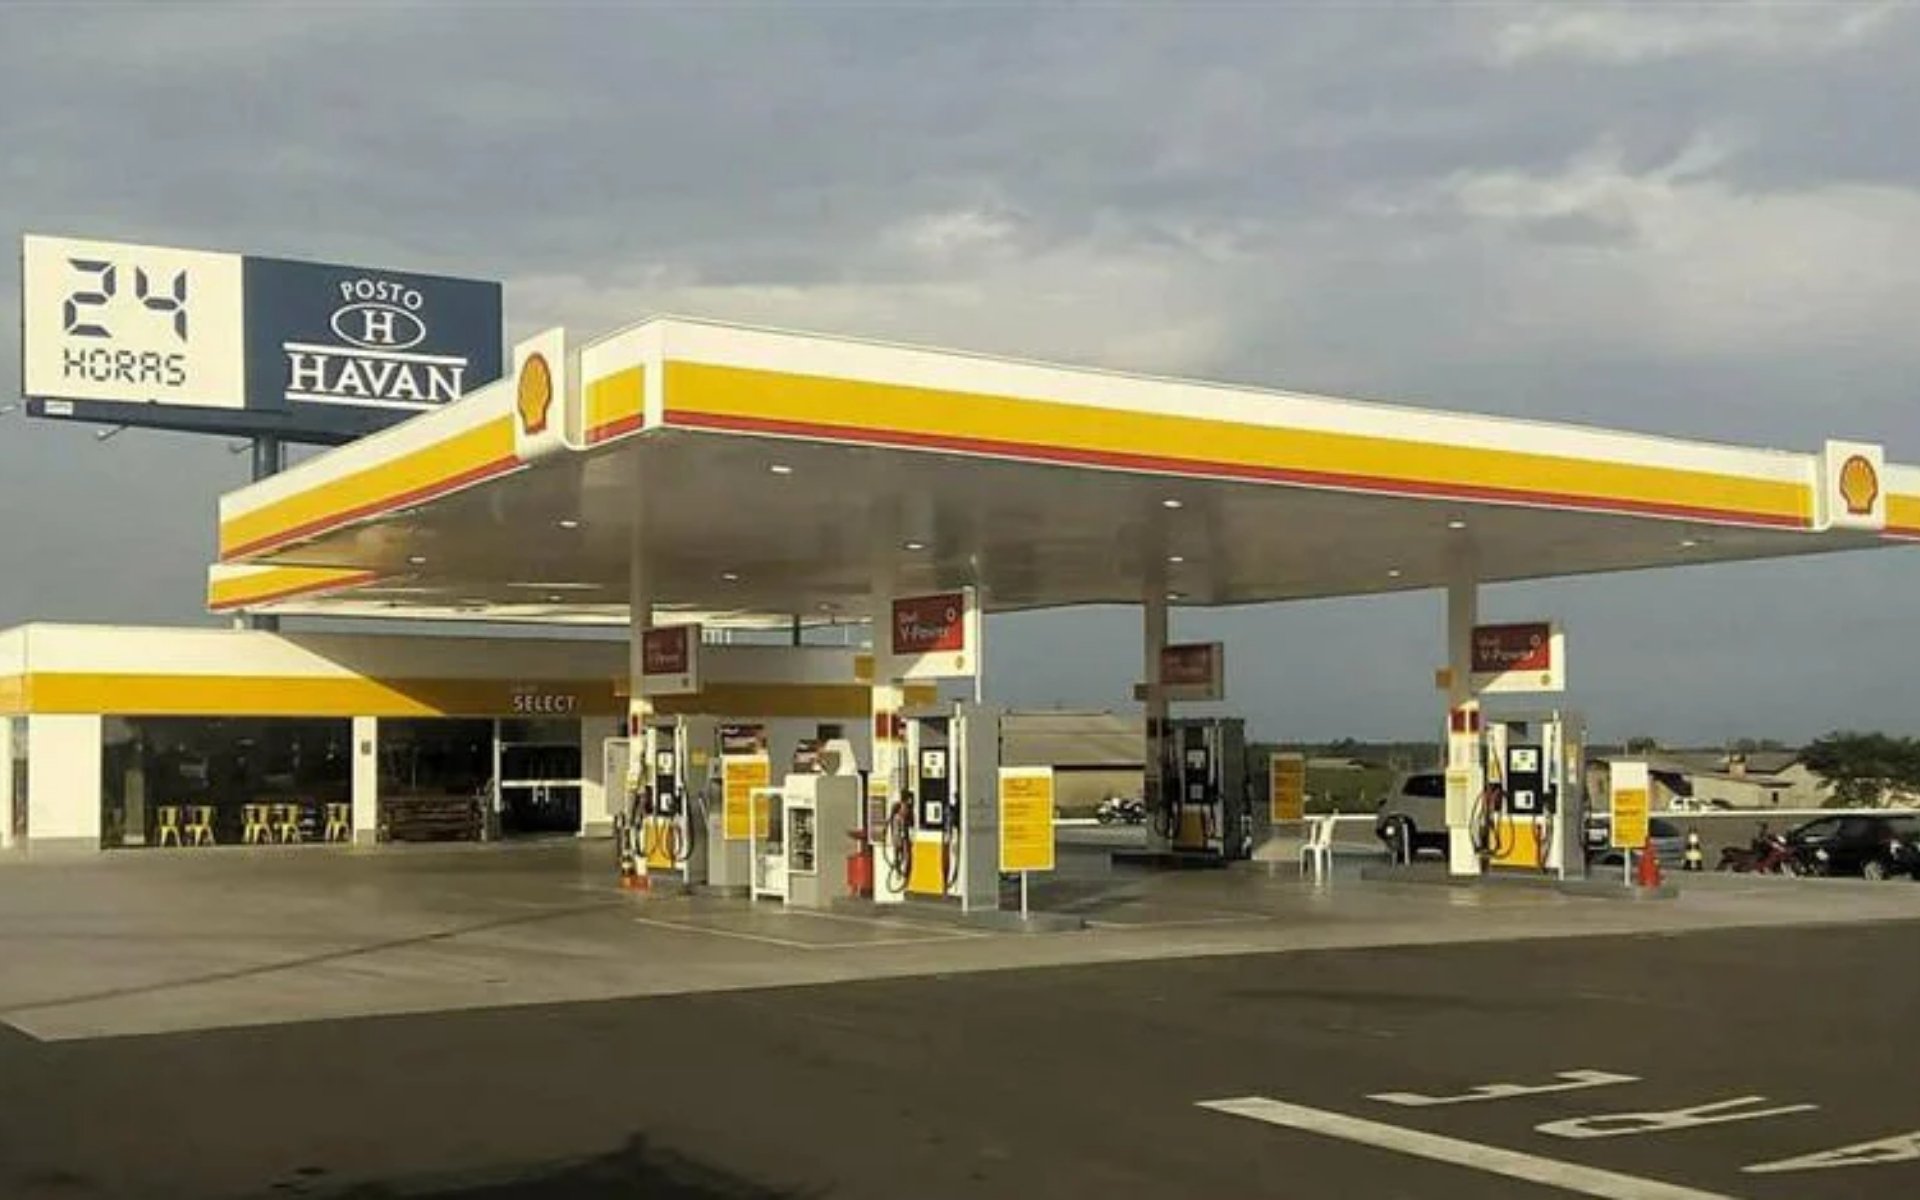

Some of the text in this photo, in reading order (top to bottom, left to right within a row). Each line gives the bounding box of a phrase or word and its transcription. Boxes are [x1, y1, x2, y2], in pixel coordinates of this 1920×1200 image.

[63, 258, 187, 343] 24
[340, 278, 423, 311] POSTO
[361, 309, 396, 344] H
[63, 348, 186, 387] HORAS
[287, 353, 464, 401] HAVAN
[512, 694, 577, 712] SELECT
